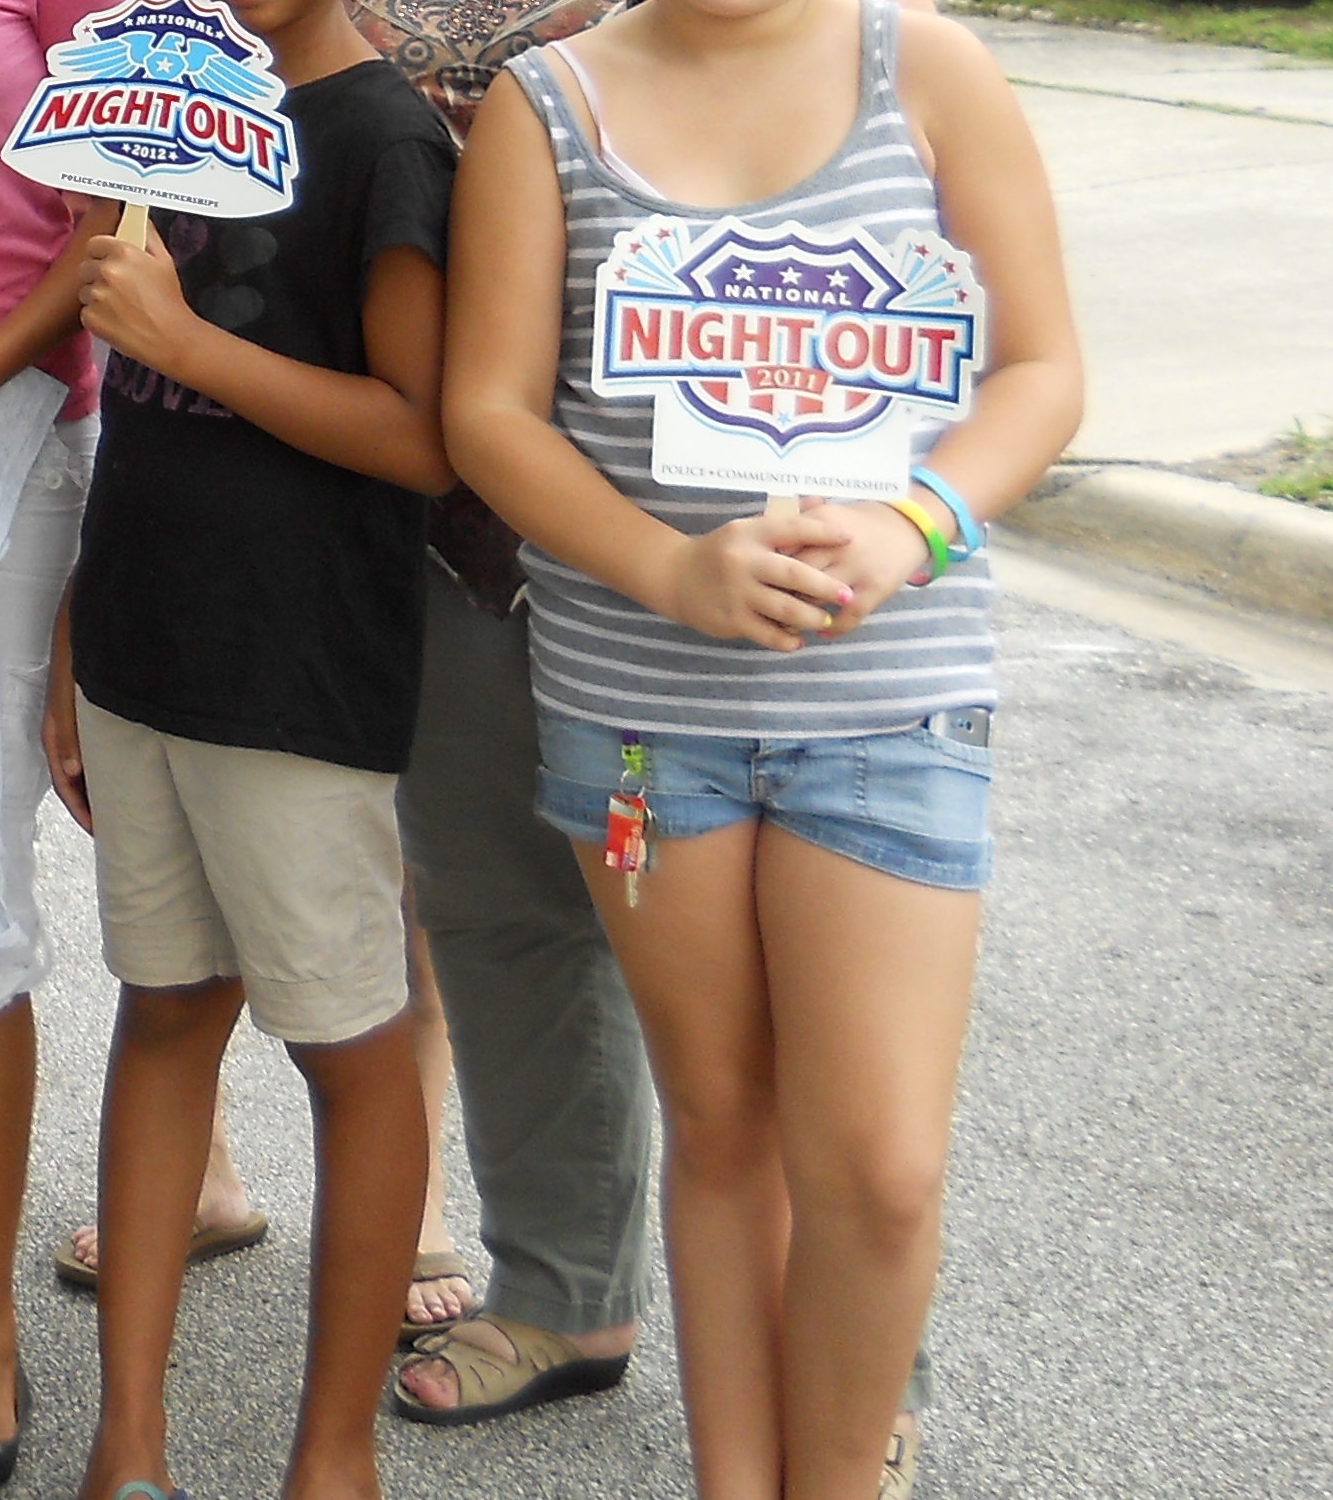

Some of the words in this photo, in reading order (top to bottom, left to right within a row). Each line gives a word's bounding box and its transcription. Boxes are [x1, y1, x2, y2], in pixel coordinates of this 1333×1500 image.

[136, 14, 214, 37] NATIONAL
[32, 89, 182, 134] NIGHT
[185, 100, 275, 171] OUT
[130, 144, 166, 161] 2012
[149, 188, 220, 209] PARTNERSHIPS
[723, 283, 852, 306] NATIONAL
[619, 305, 816, 365] NIGHT
[823, 321, 958, 384] OUT
[756, 368, 817, 391] 2011
[661, 463, 707, 478] POLICE
[716, 467, 801, 486] COMMUNITY
[803, 474, 900, 493] PARTNERSHIPS
